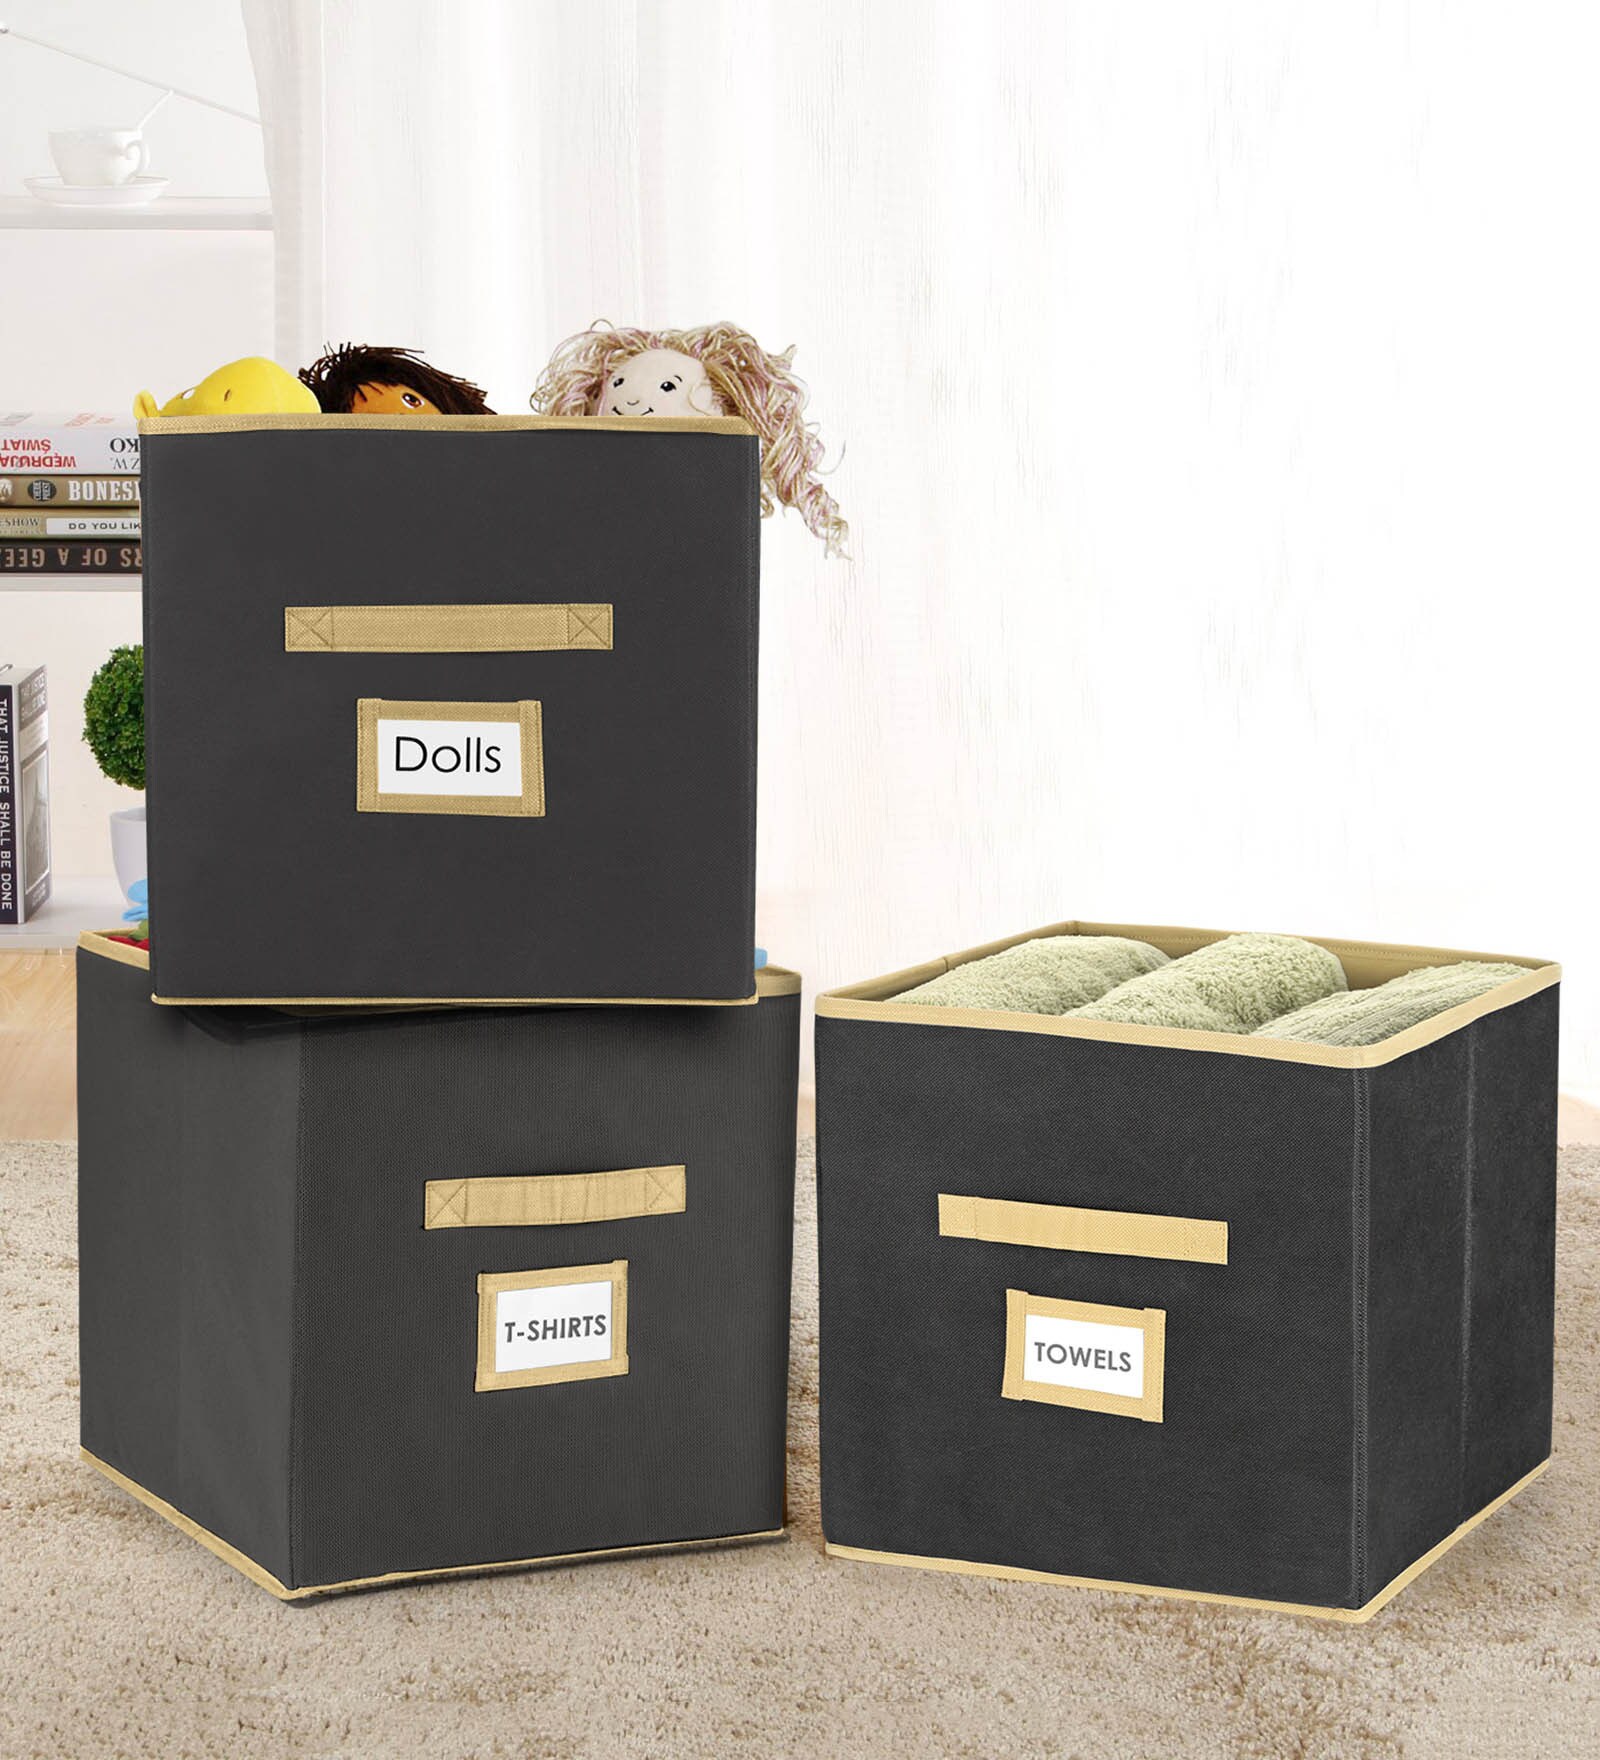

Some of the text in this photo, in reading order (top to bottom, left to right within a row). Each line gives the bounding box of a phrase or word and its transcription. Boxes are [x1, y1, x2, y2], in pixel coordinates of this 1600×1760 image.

[1, 439, 51, 454] ŚWIAT
[68, 522, 87, 530] DO
[91, 522, 117, 530] YOU
[57, 548, 69, 566] A
[81, 548, 107, 566] OF
[395, 736, 502, 773] Dolls
[0, 698, 12, 910] THAT JUSTICE SHALL BE DONE
[504, 1314, 607, 1343] T-SHIRTS
[1034, 1341, 1132, 1372] TOWELS
